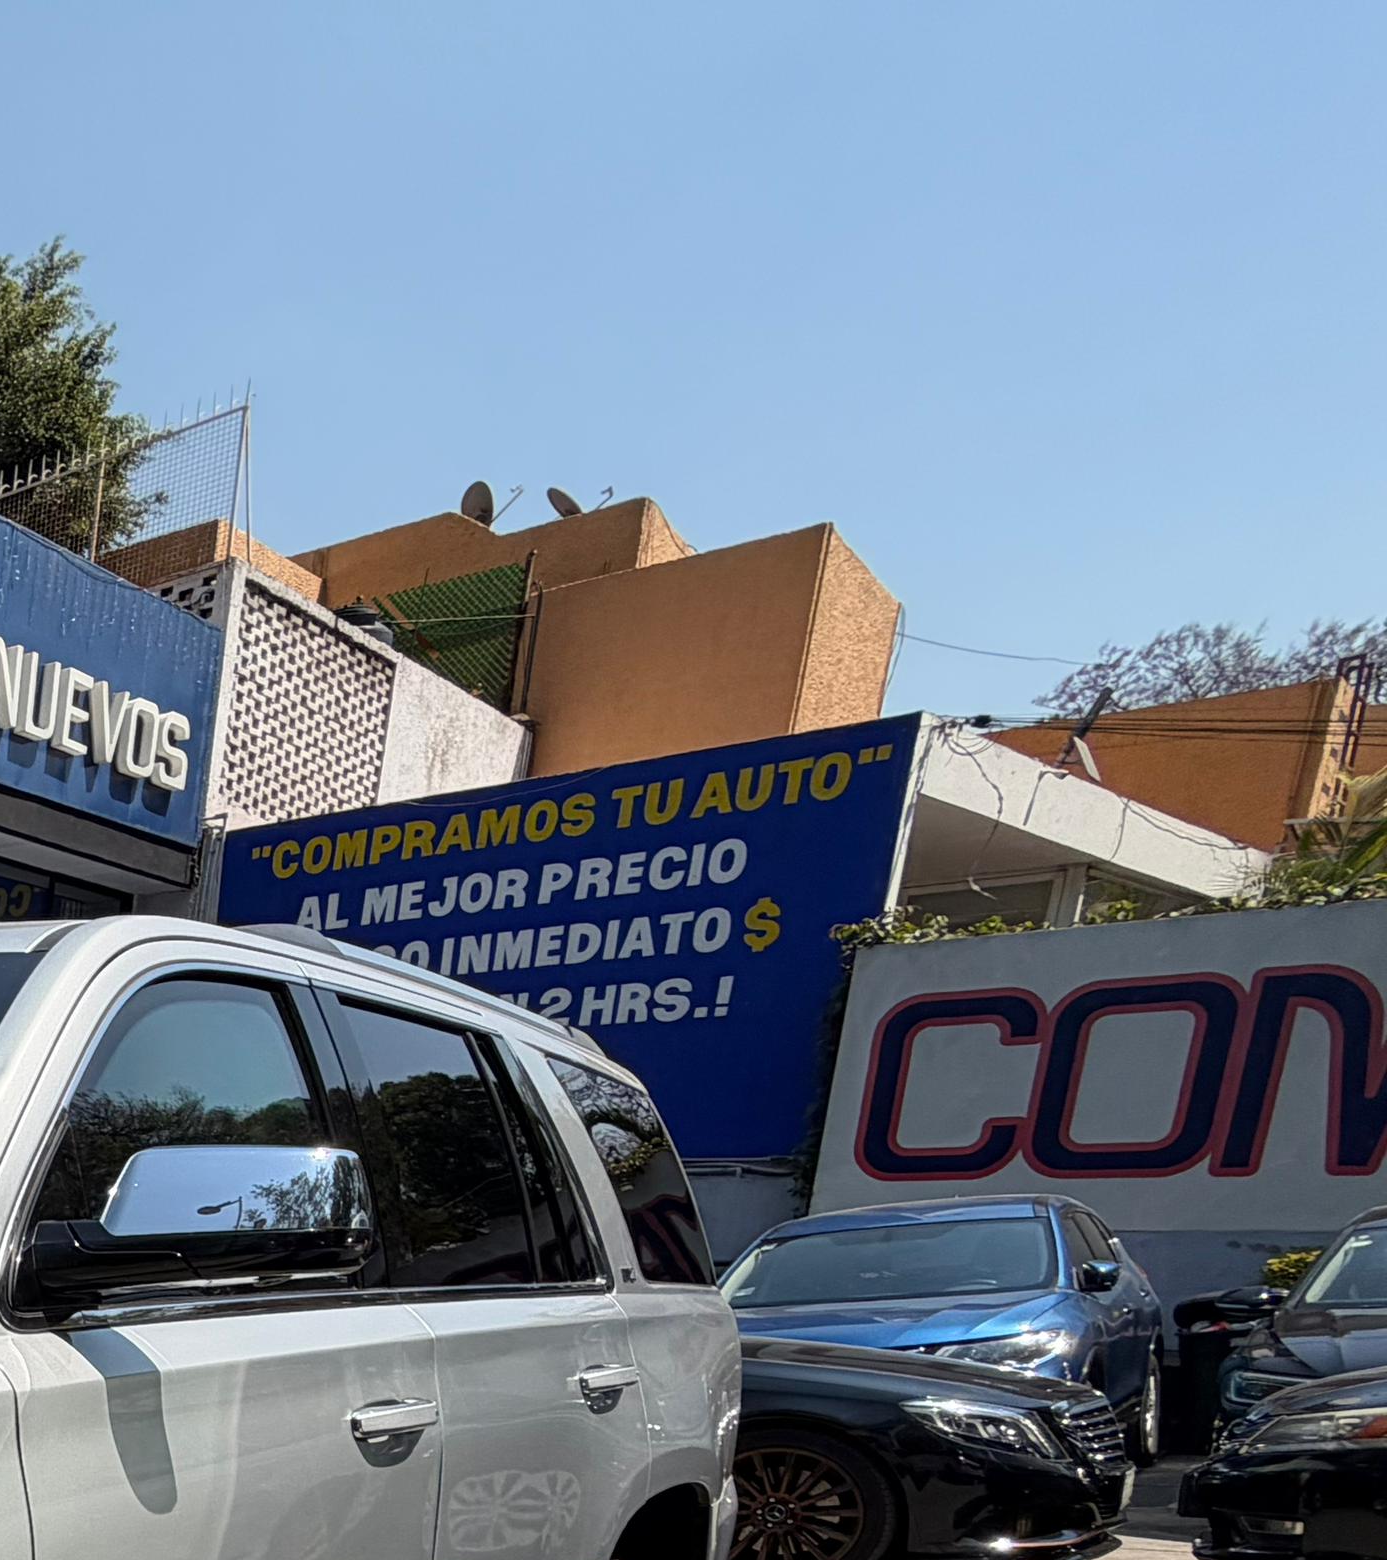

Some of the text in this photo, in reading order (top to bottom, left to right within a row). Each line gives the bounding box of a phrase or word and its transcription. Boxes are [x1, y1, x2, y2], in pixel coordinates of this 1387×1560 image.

[252, 744, 893, 879] "COMPRAMOS TU AUTO"
[297, 838, 748, 931] AL MEJOR PRECIO
[440, 907, 731, 976] INMEDIATO
[539, 976, 734, 1026] 2 HRS.!
